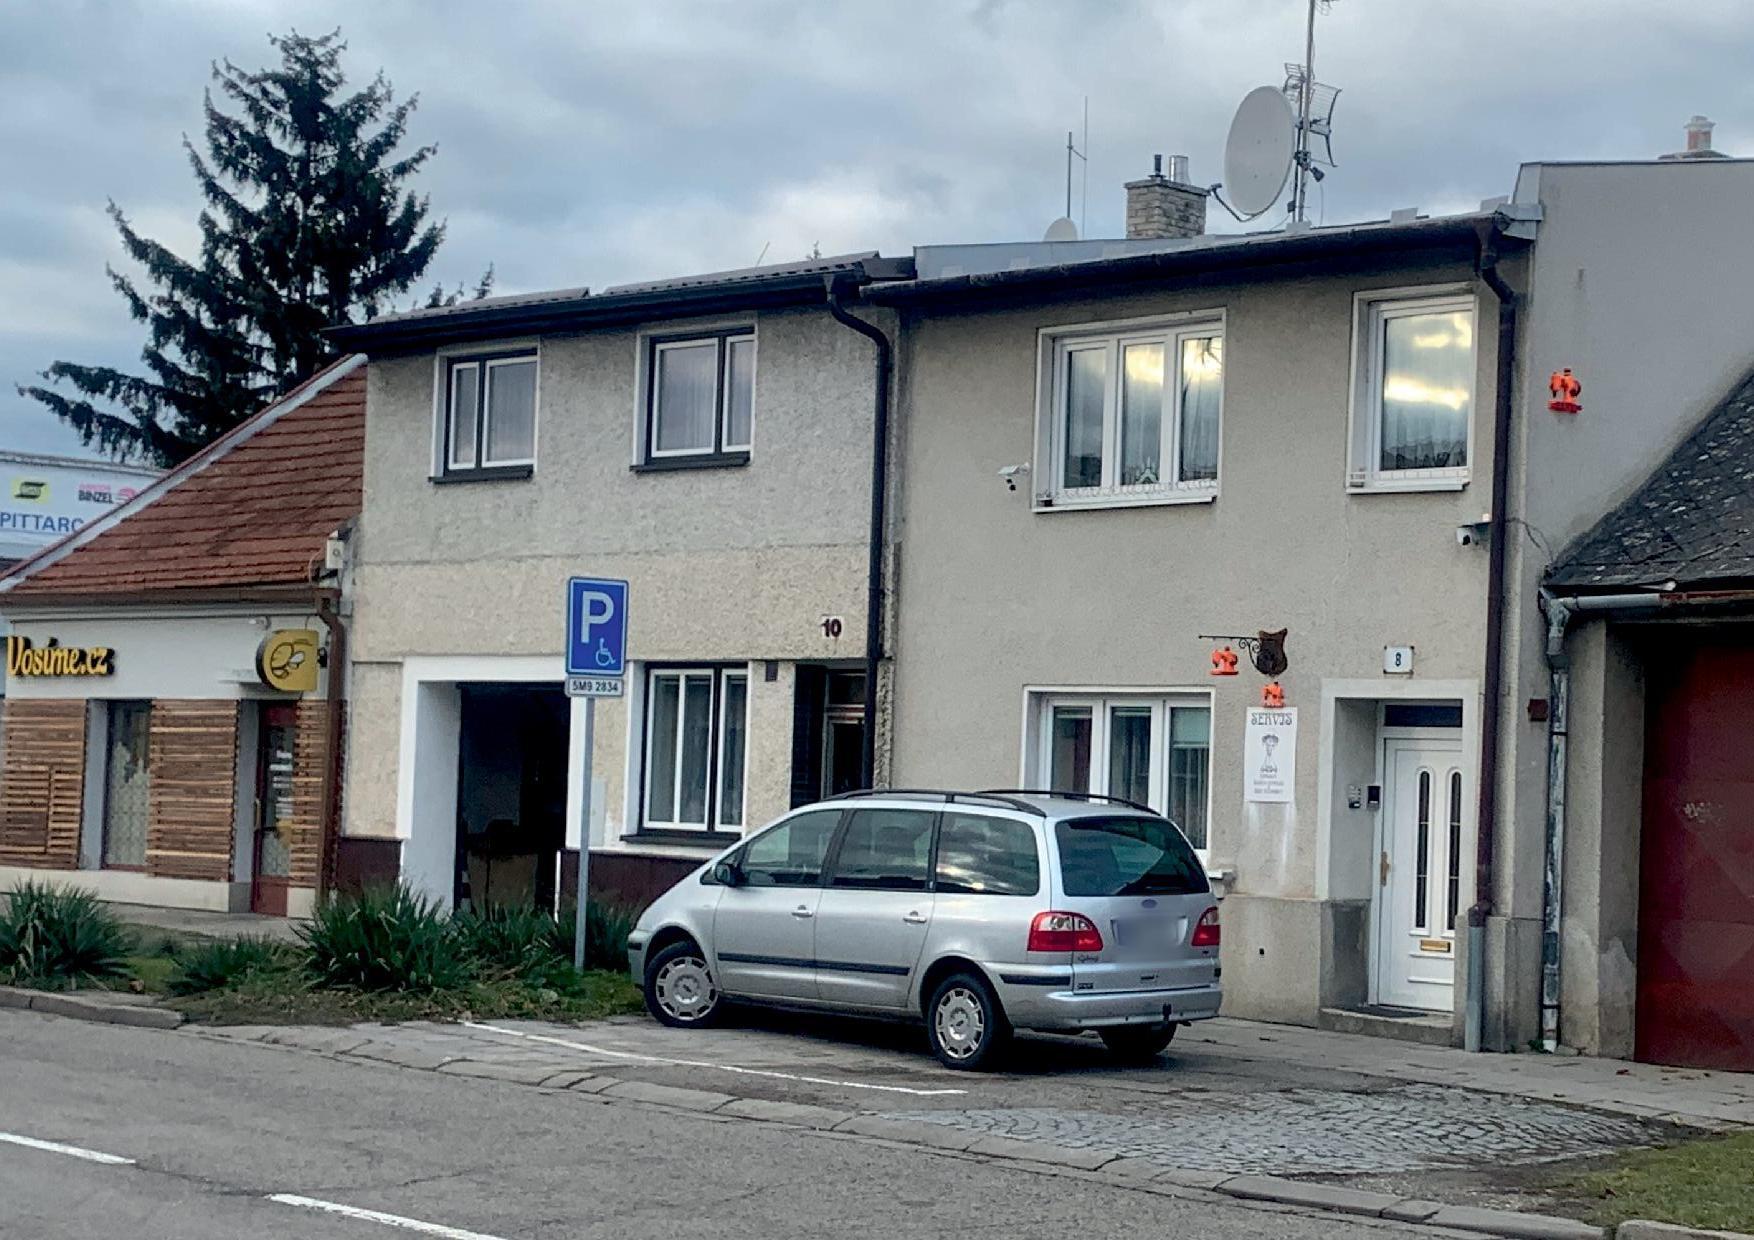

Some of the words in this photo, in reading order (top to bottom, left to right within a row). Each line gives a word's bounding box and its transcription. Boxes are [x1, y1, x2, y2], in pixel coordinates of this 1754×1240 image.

[581, 590, 614, 643] P
[821, 618, 842, 637] 10
[1395, 651, 1402, 667] 8
